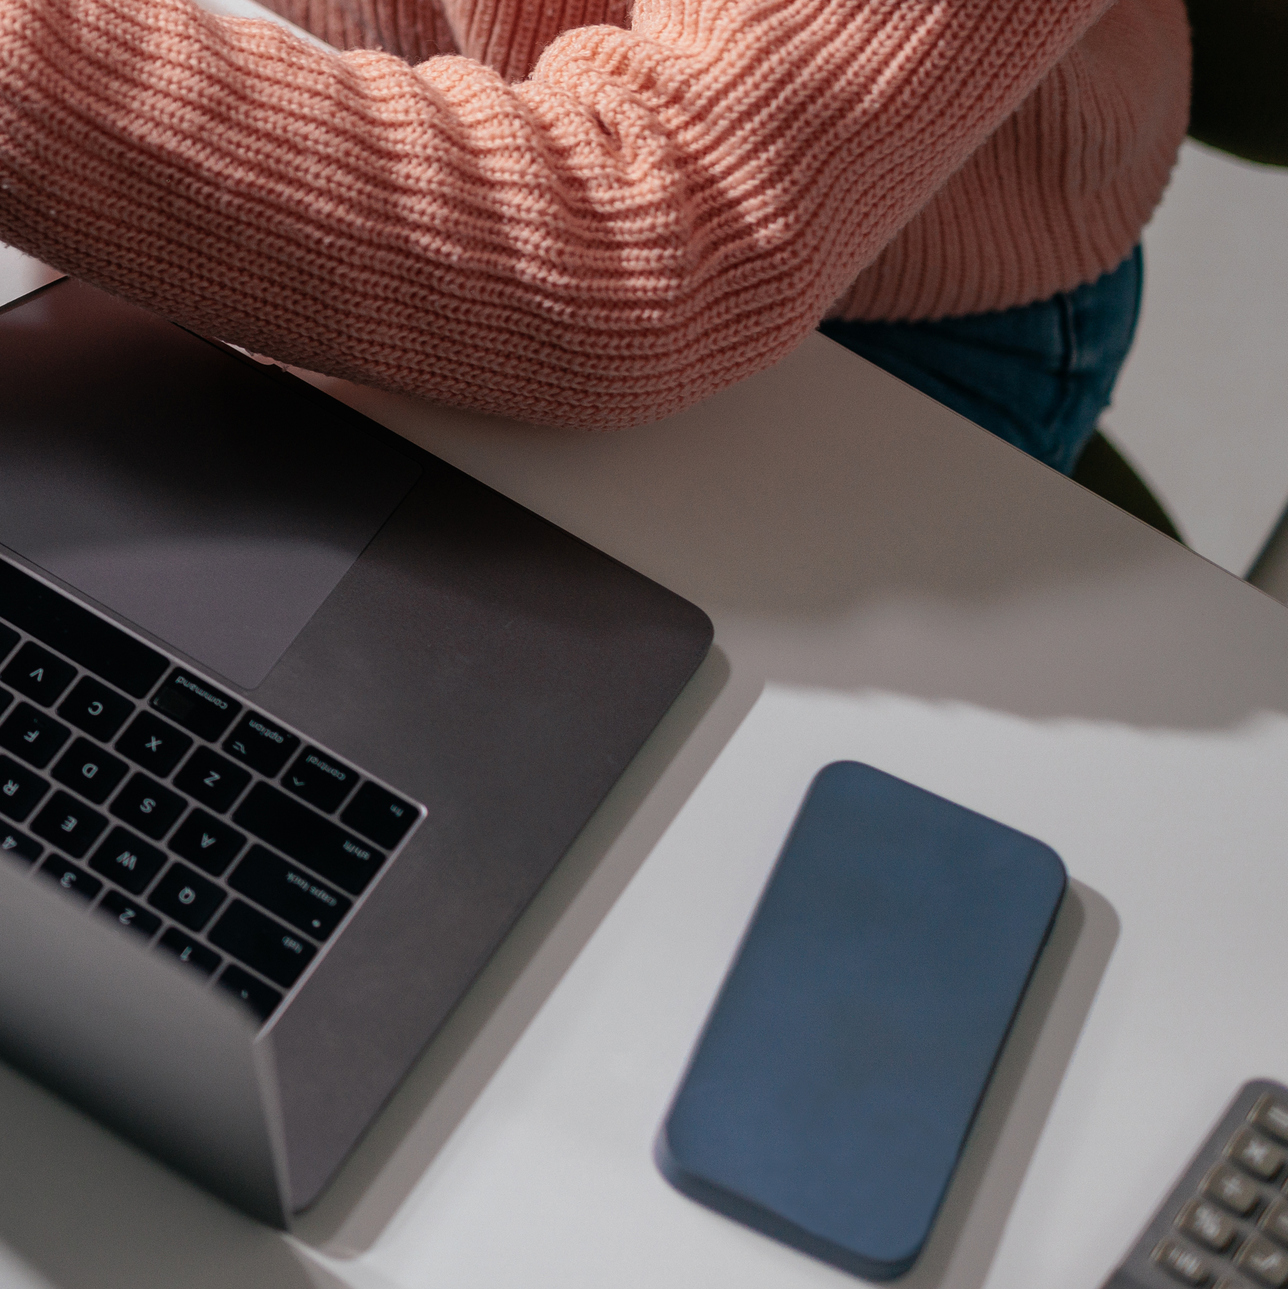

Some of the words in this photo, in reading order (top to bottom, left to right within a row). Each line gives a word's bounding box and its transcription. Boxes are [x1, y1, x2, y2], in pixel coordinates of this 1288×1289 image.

[28, 666, 45, 683] V
[174, 674, 229, 711] command
[86, 700, 105, 717] C
[22, 729, 41, 744] F
[247, 718, 285, 744] option
[144, 735, 163, 752] X
[80, 762, 100, 780] D
[304, 754, 347, 781] control
[1, 778, 20, 797] R
[202, 769, 222, 787] Z
[138, 796, 157, 814] S
[60, 814, 79, 833] E
[0, 834, 18, 851] 4
[200, 831, 217, 849] A
[342, 839, 371, 861] shift
[115, 850, 138, 871] W
[58, 871, 77, 890] 3
[286, 871, 310, 891] lock
[177, 885, 197, 905] Q
[309, 885, 337, 906] caps
